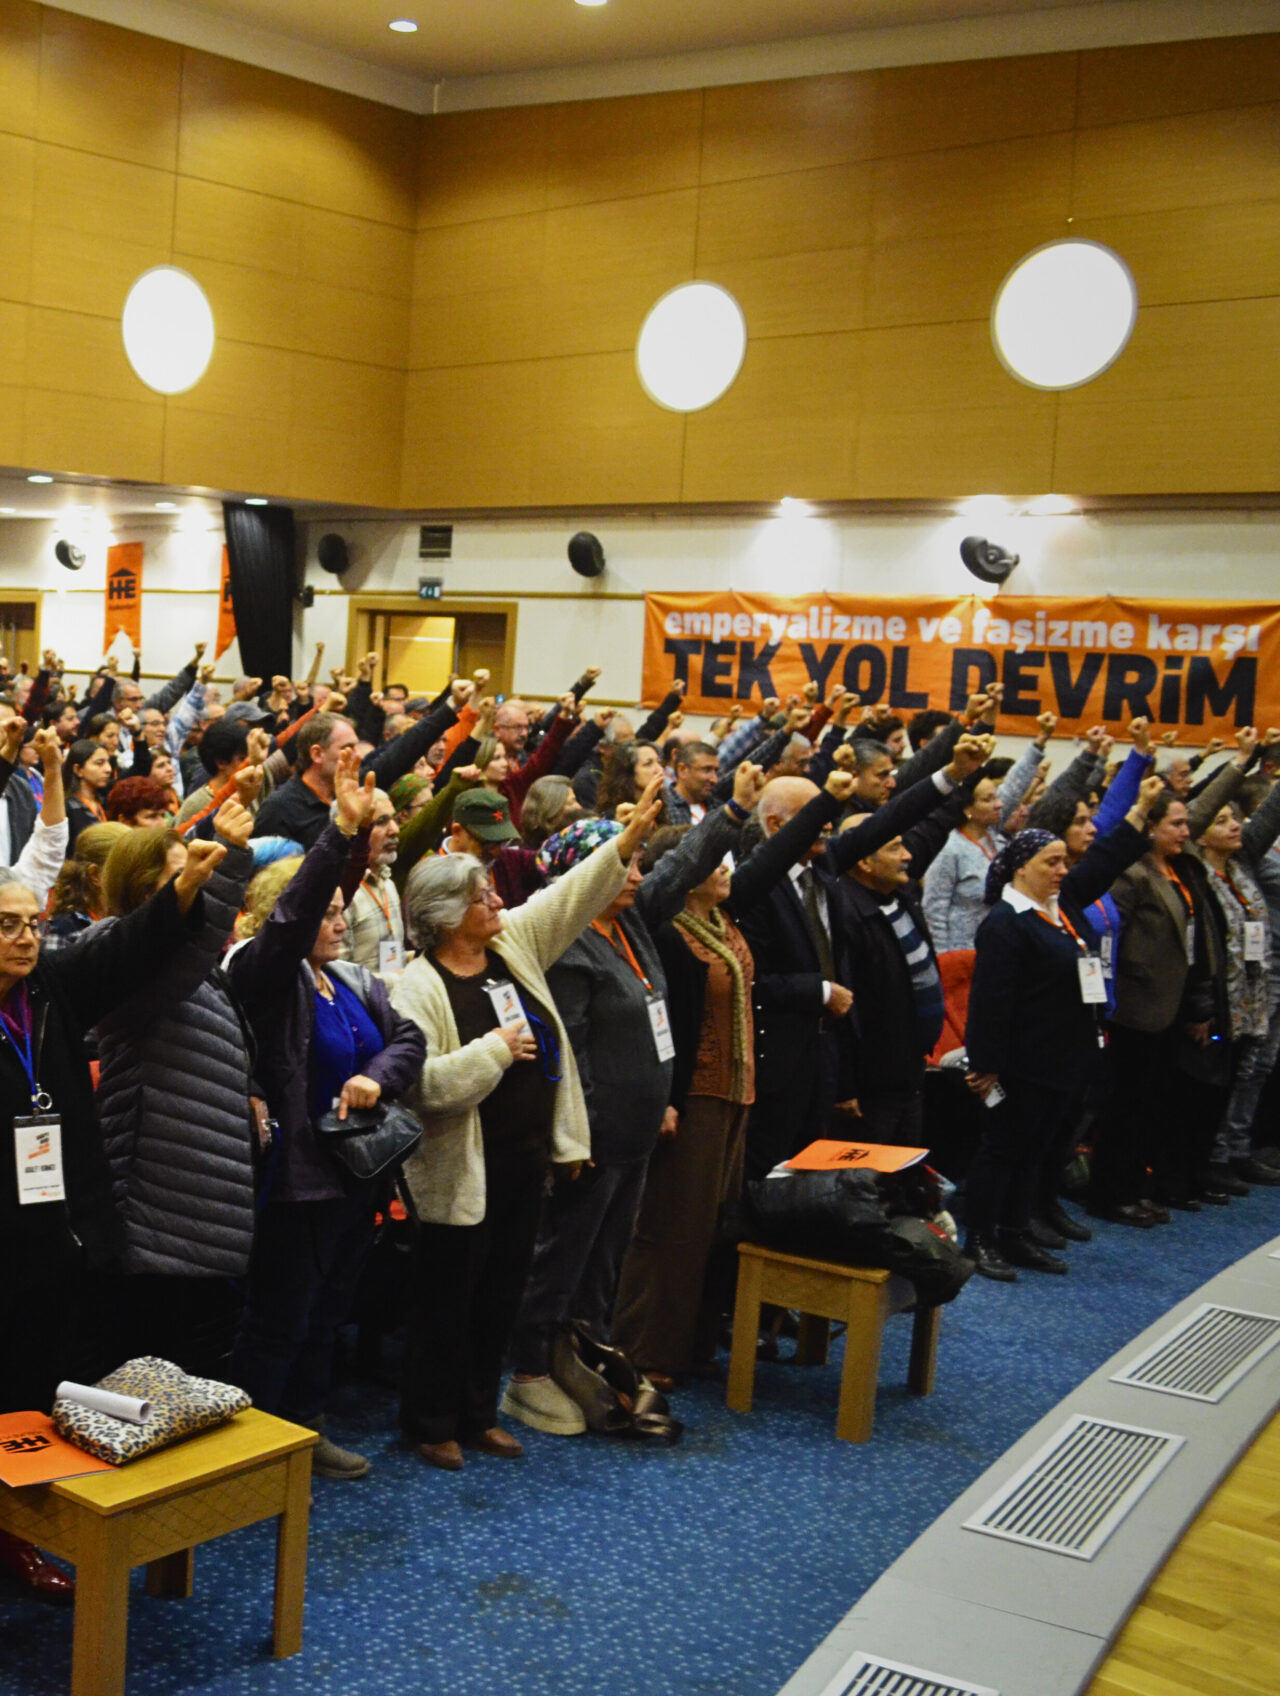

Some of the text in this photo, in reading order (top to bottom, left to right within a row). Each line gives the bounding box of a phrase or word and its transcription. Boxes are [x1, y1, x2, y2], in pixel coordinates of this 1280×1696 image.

[664, 606, 1262, 660] emperyalizme ve faşizme karşı
[664, 638, 782, 701] TEK
[798, 642, 929, 709] YOL
